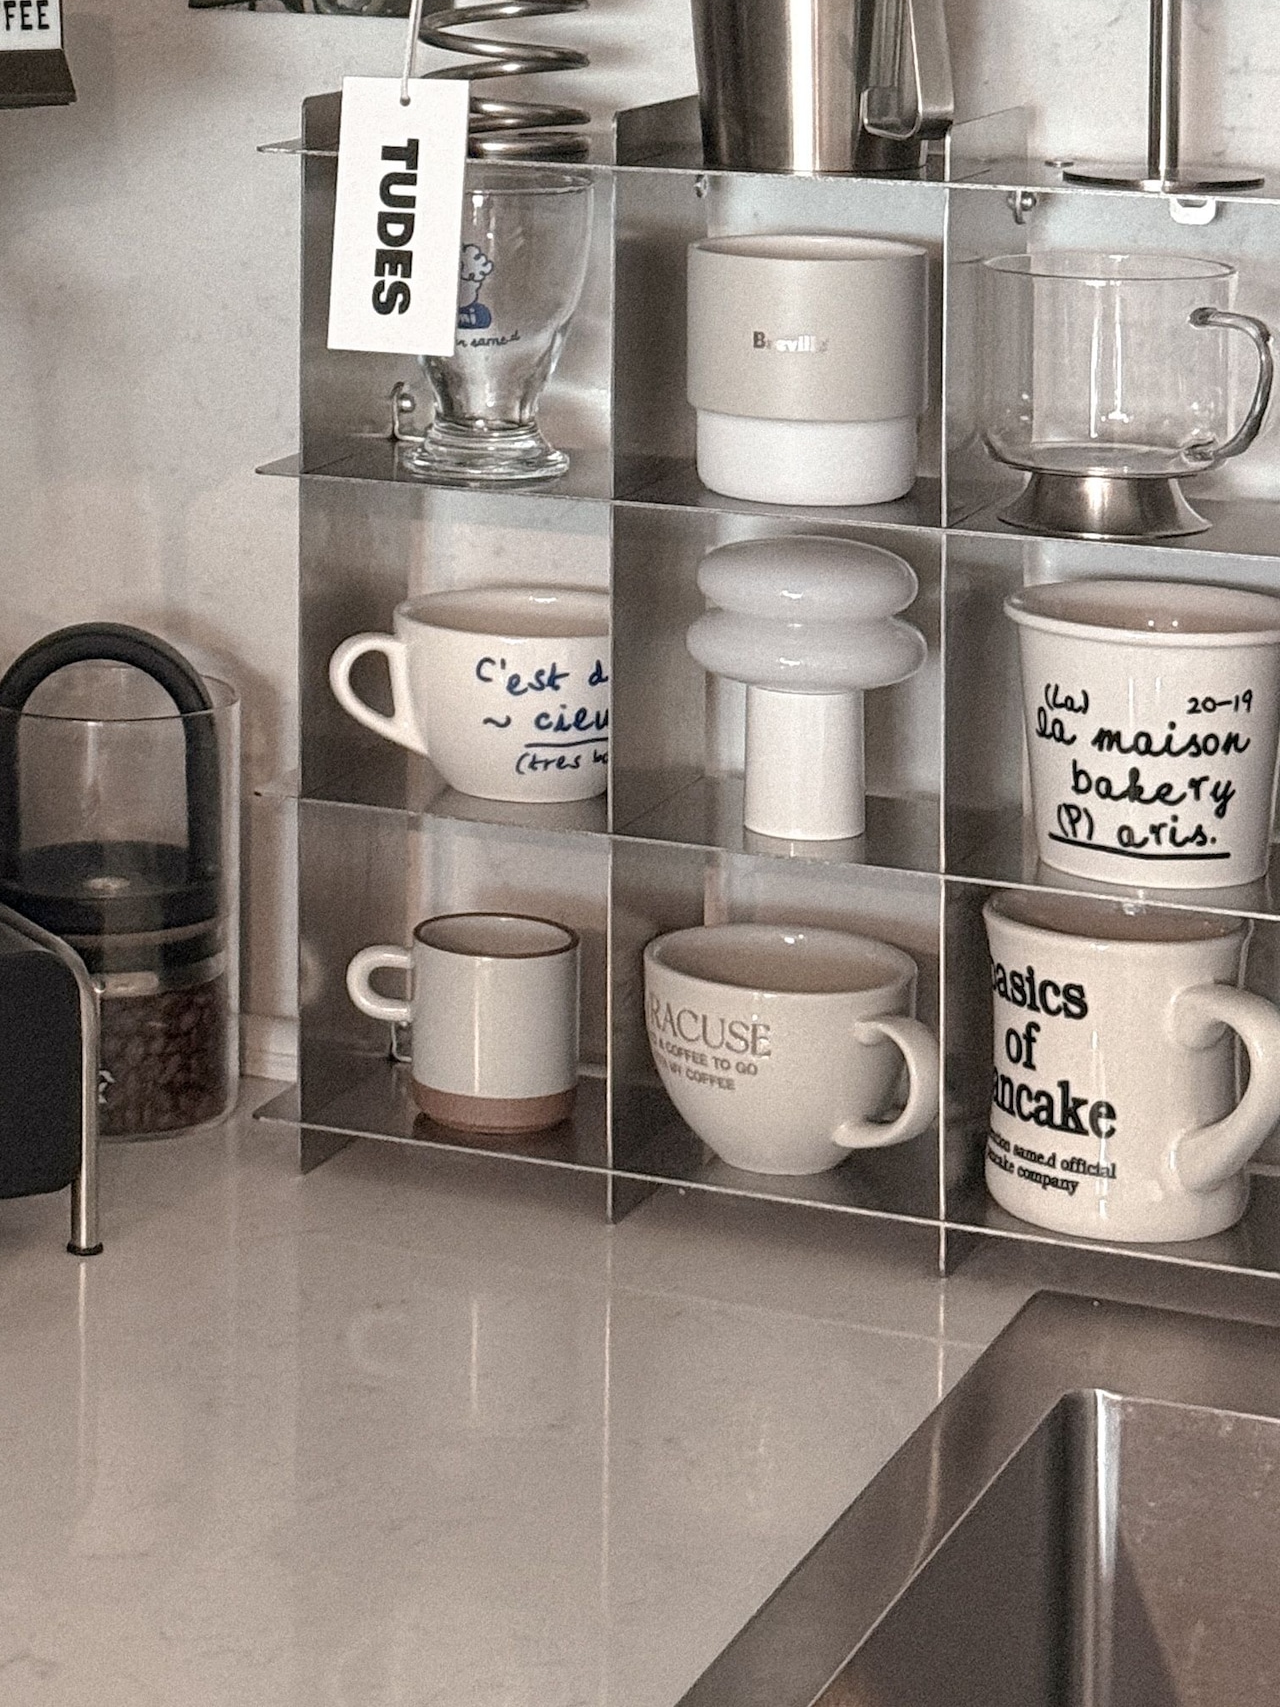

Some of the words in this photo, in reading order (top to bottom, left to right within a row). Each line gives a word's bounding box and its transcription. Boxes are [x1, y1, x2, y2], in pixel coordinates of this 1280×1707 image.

[371, 138, 420, 315] TUDES
[476, 657, 570, 696] C'est
[588, 659, 609, 686] d
[534, 703, 609, 732] cieu
[1036, 706, 1077, 745] la
[1091, 721, 1251, 757] maison
[1071, 759, 1236, 818] bakery
[989, 958, 1088, 1020] asics
[645, 993, 771, 1057] RACUSE
[1005, 1021, 1041, 1070] of
[666, 1041, 709, 1067] COFFEE
[712, 1056, 731, 1072] TO
[735, 1061, 758, 1076] GO
[685, 1068, 736, 1091] COFFEE
[1017, 1165, 1080, 1196] company
[1060, 1155, 1117, 1179] official
